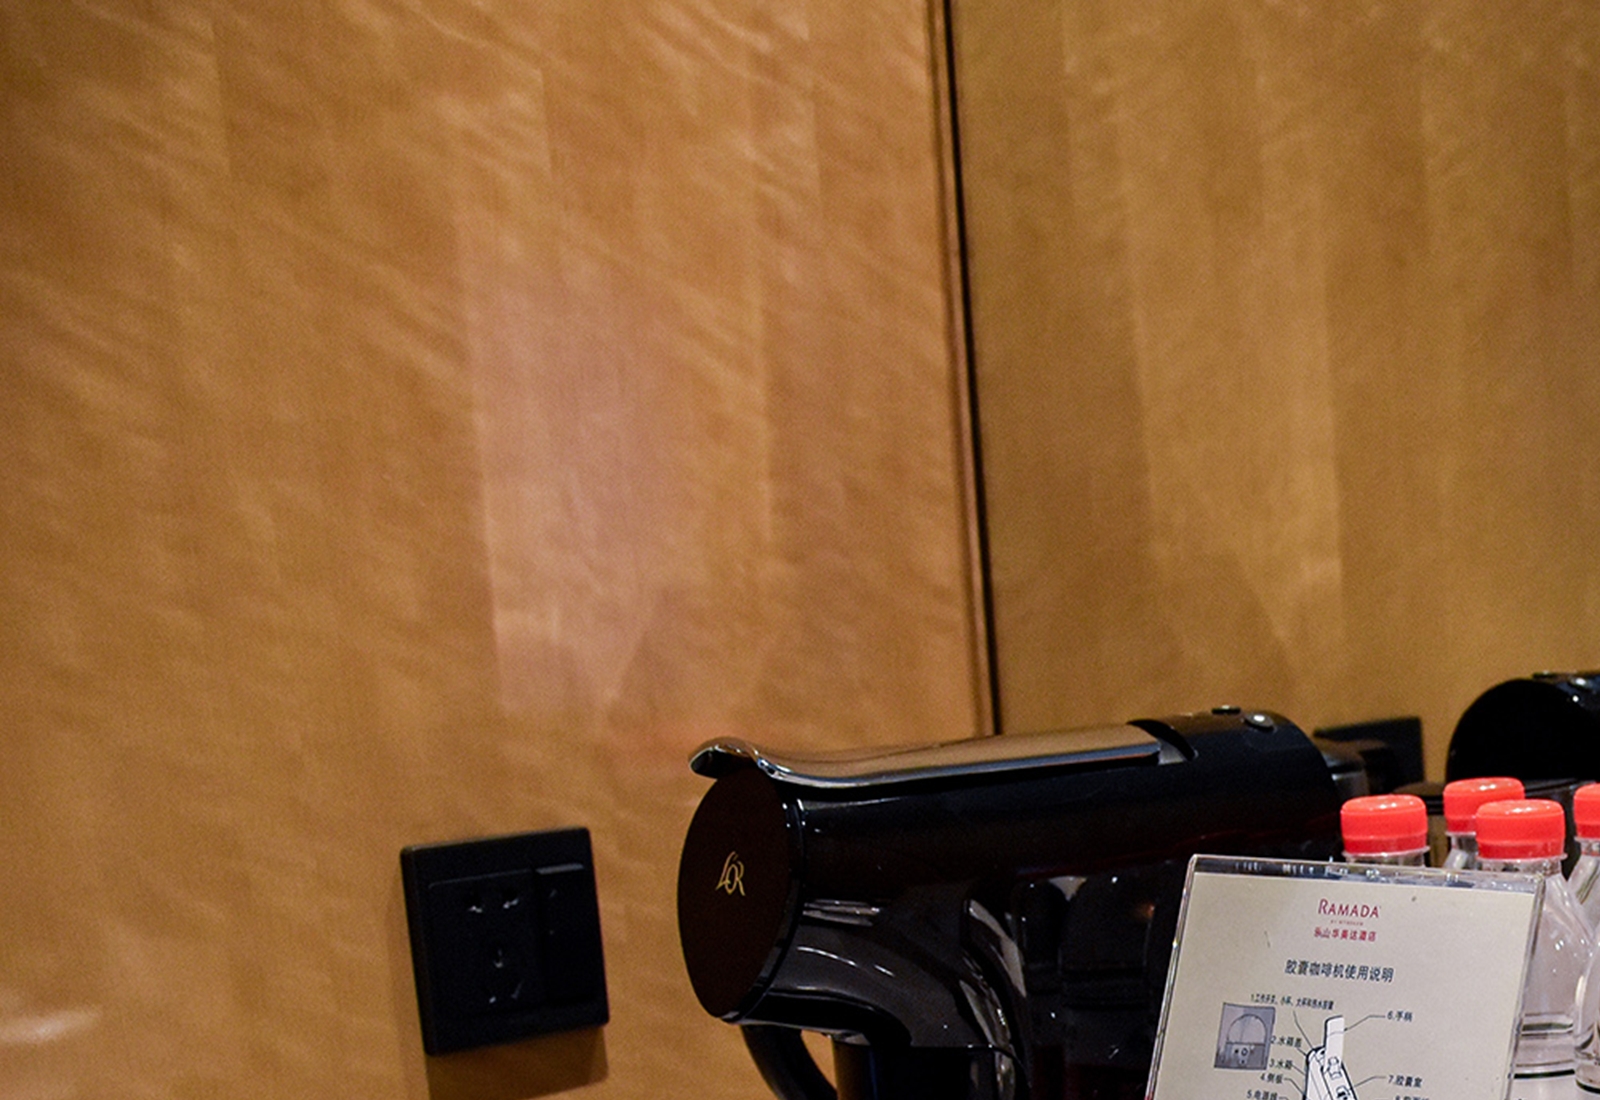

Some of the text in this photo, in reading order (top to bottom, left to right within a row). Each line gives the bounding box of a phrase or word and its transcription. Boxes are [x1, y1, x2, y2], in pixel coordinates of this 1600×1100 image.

[1318, 898, 1379, 918] RAMADA
[1285, 959, 1394, 983] 胶囊咖啡机使用说明
